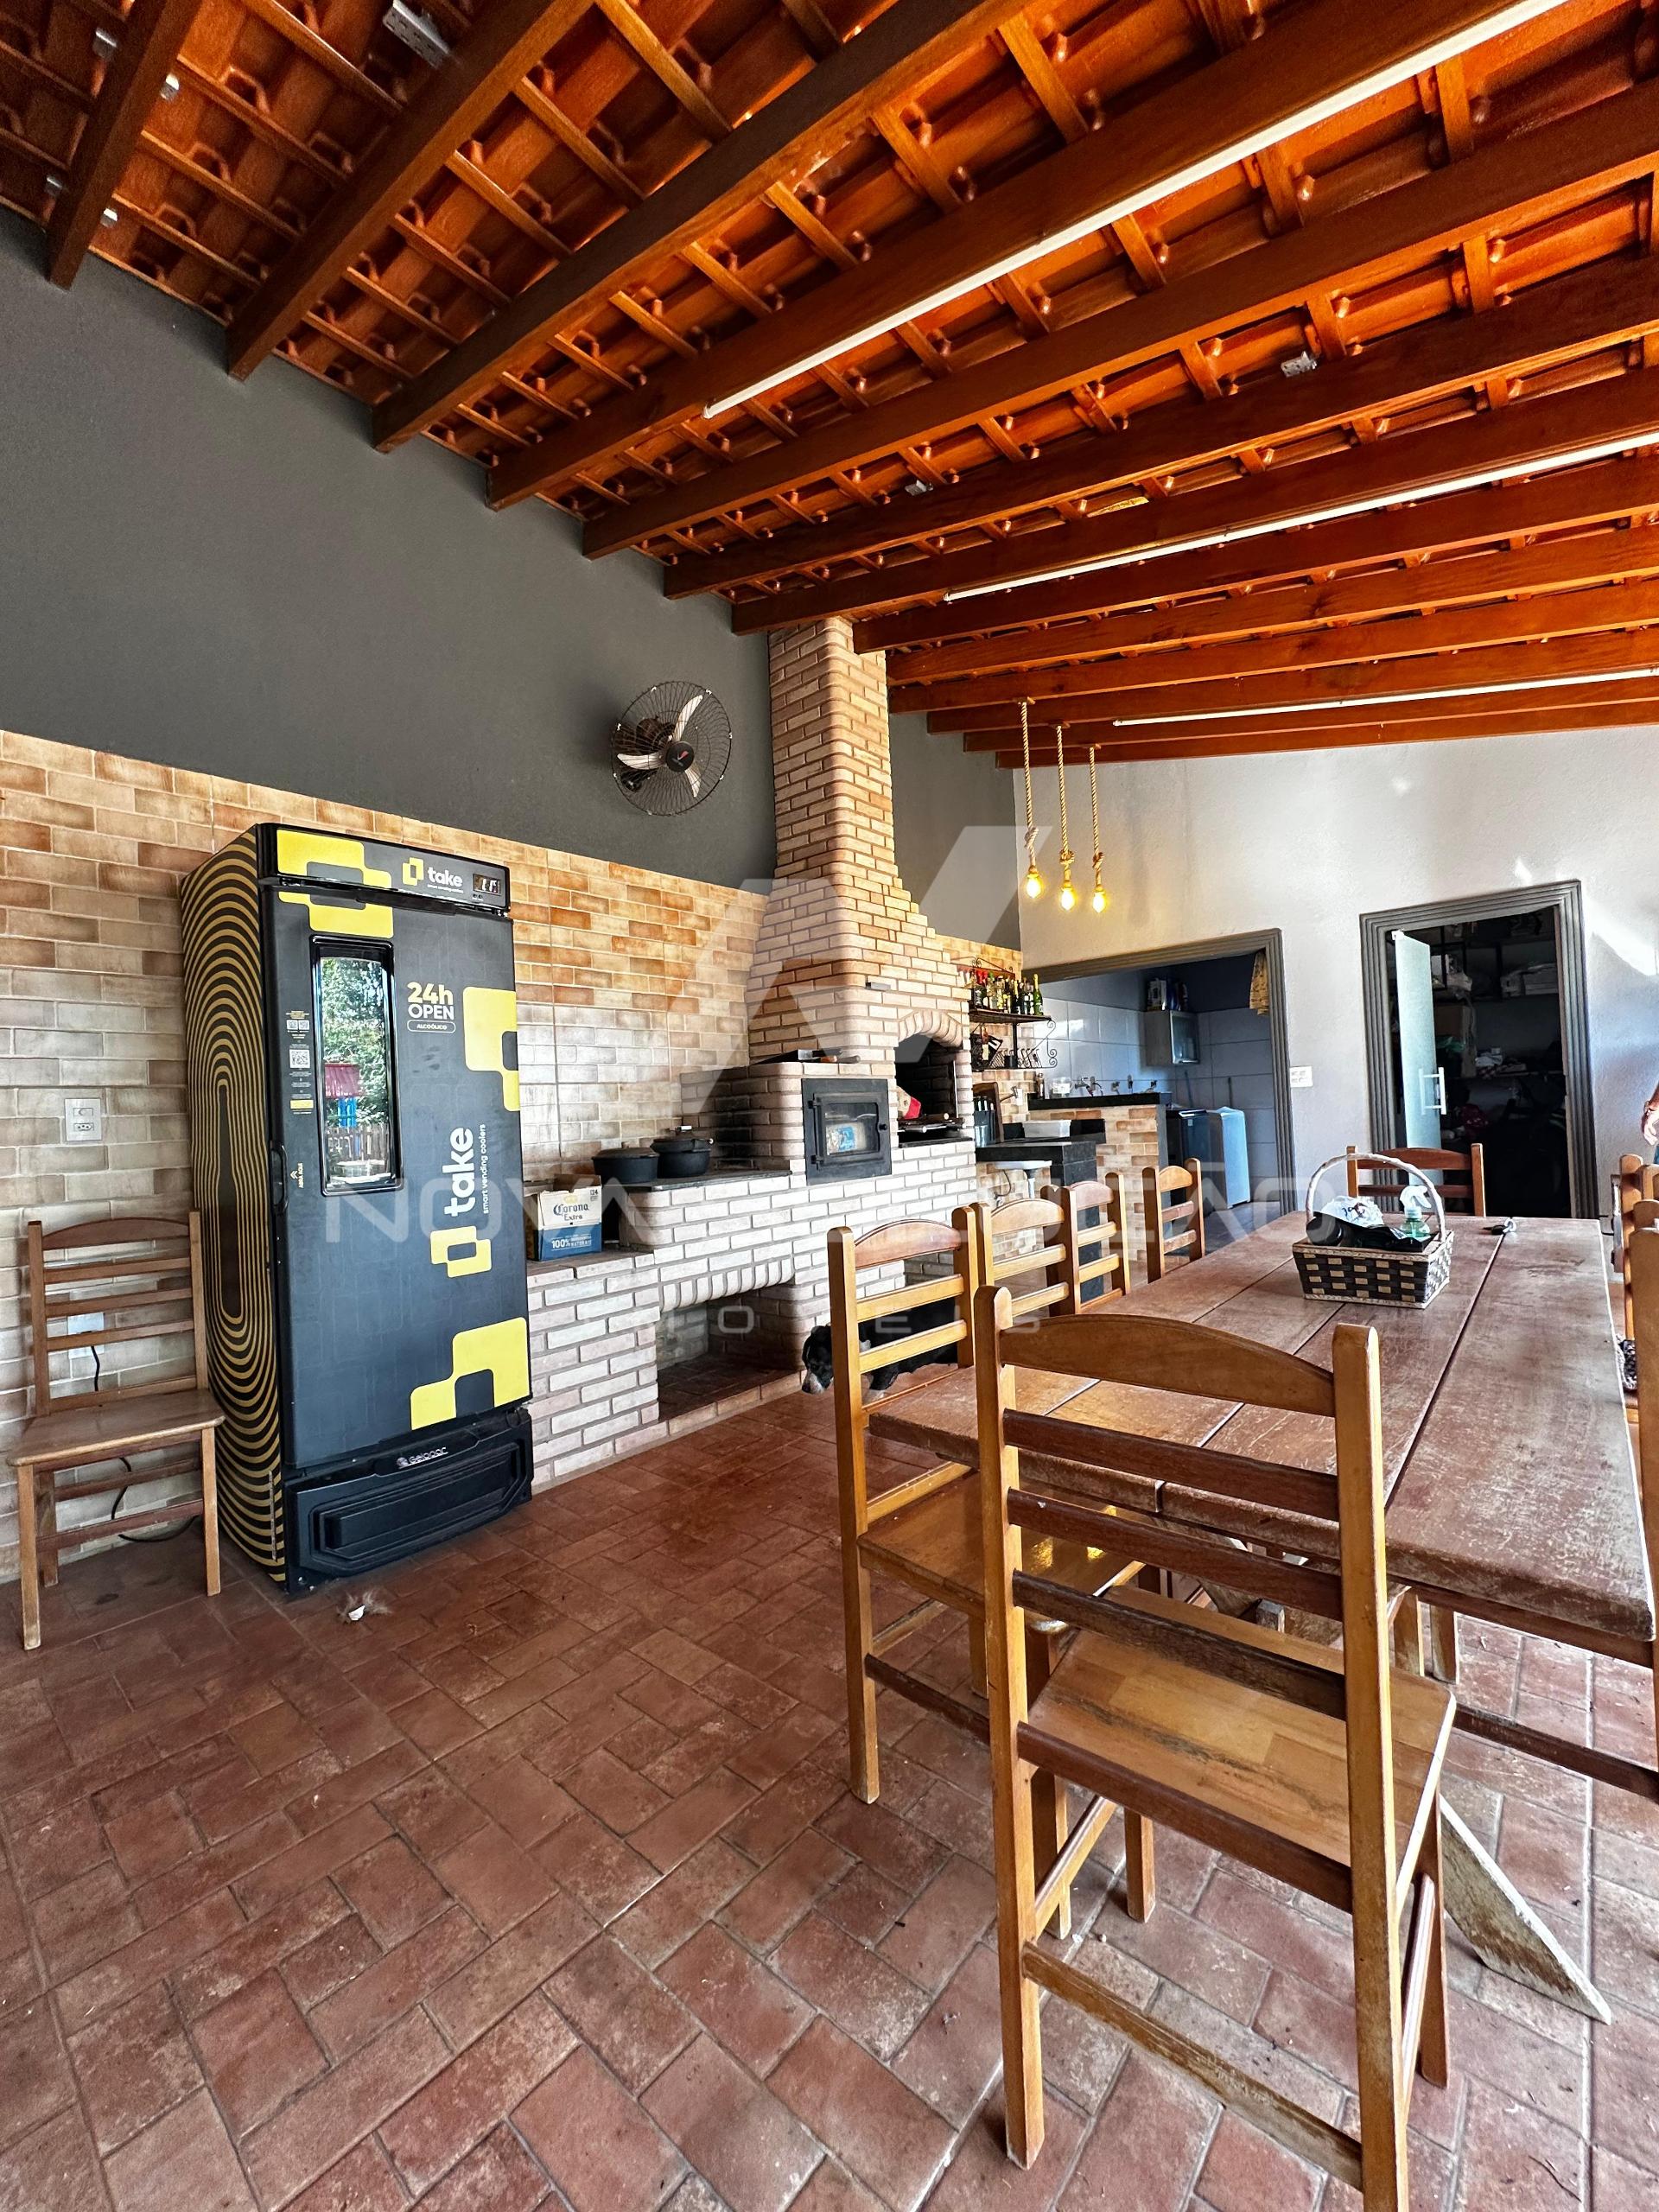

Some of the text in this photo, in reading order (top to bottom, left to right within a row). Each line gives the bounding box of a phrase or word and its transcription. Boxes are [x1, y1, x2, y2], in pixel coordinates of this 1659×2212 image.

[427, 867, 463, 887] take
[407, 982, 454, 1005] 24h
[408, 1004, 454, 1020] OPEN
[479, 1124, 487, 1154] coolers
[442, 1128, 476, 1217] take
[553, 1204, 589, 1216] Corona
